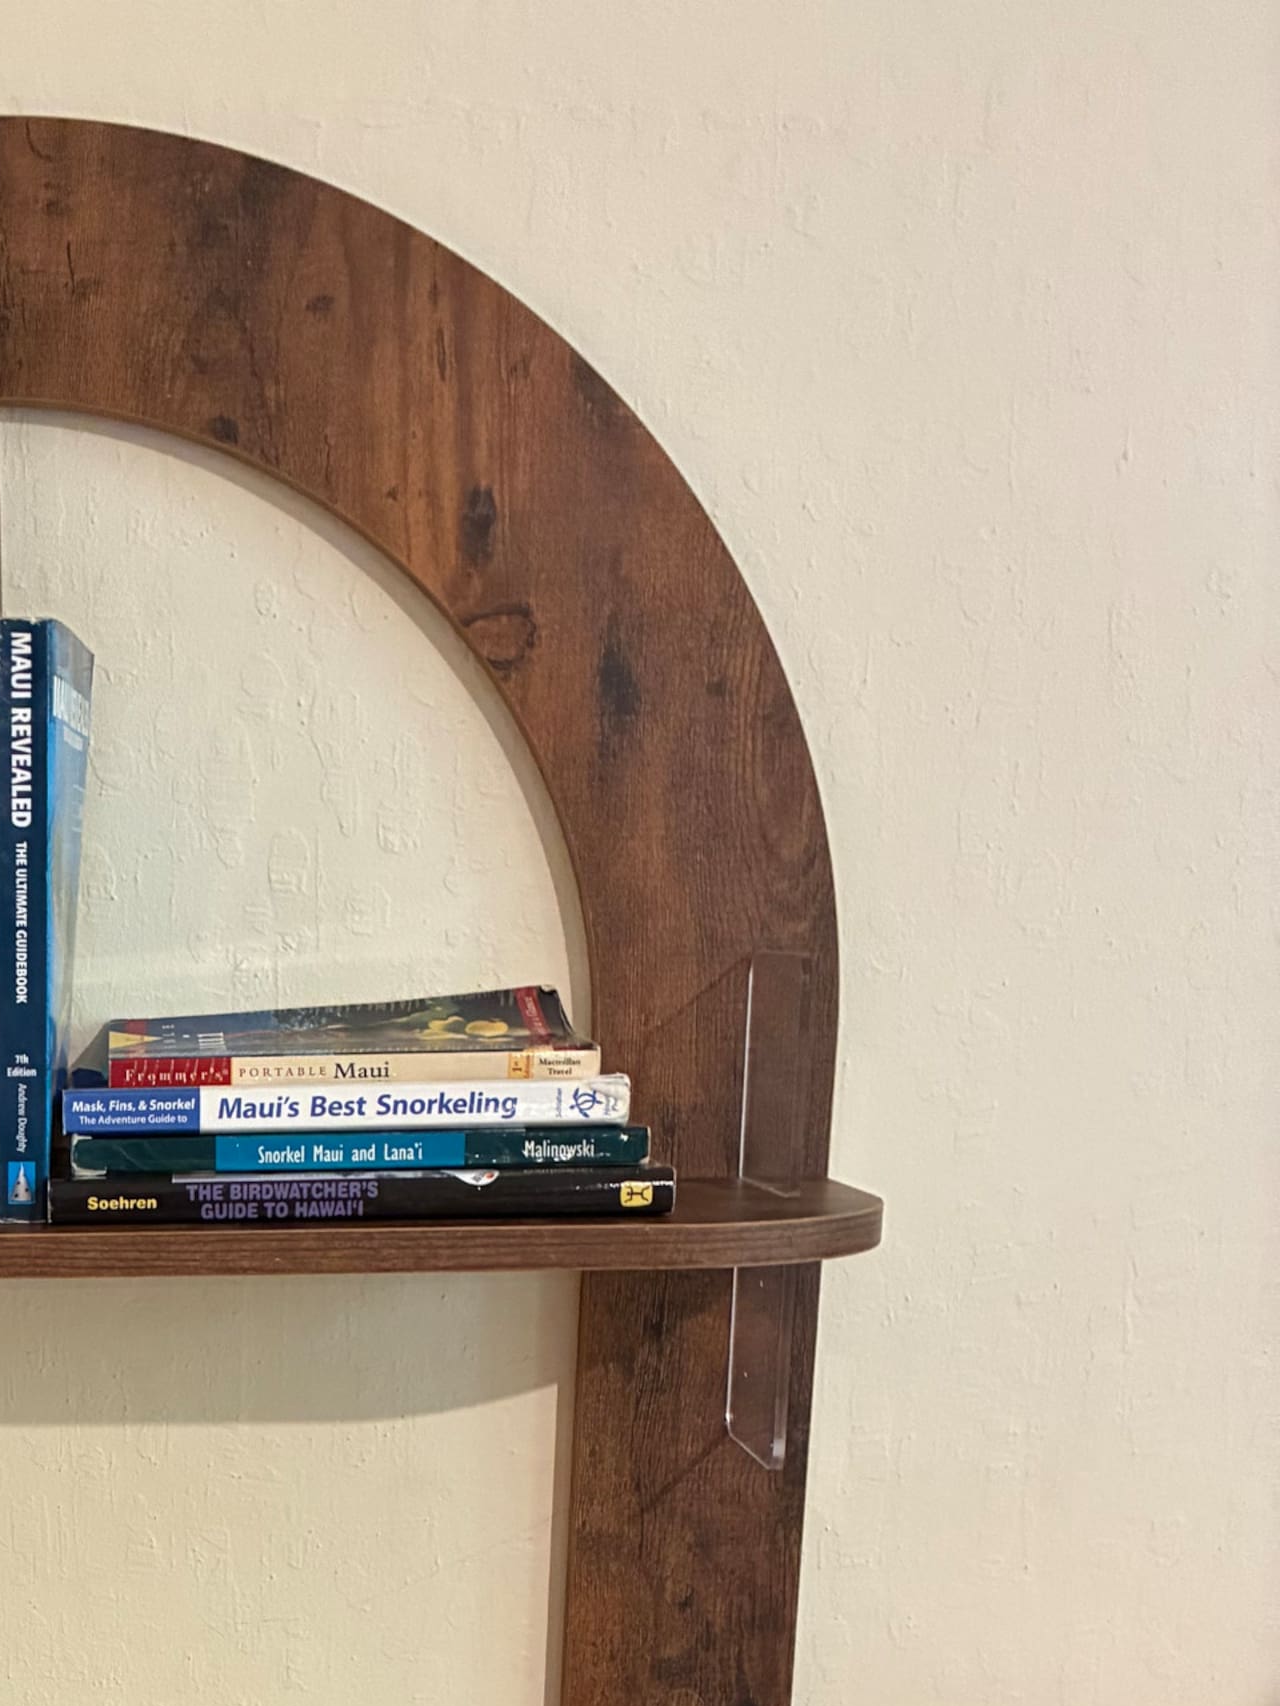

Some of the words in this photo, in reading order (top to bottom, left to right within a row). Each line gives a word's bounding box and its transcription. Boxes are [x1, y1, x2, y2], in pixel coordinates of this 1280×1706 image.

[10, 632, 32, 699] MAUI
[11, 707, 32, 828] REVEALED
[16, 841, 27, 866] THE
[15, 868, 27, 927] ULTIMATE
[15, 929, 27, 1004] GUIDEBOOK
[7, 1066, 37, 1077] Edition
[239, 1066, 327, 1078] PORTABLE
[334, 1061, 390, 1079] Maui
[539, 1057, 581, 1066] Macmillan
[547, 1067, 572, 1075] Travel
[17, 1083, 28, 1116] Andrew
[72, 1100, 106, 1113] Mask,
[109, 1099, 136, 1112] Fins,
[138, 1100, 147, 1111] &
[148, 1098, 195, 1111] Snorkel
[218, 1096, 299, 1119] Maui's
[310, 1096, 366, 1117] Best
[376, 1091, 518, 1118] Snorkeling
[79, 1115, 96, 1125] The
[98, 1114, 146, 1125] Adventure
[148, 1112, 176, 1124] Guide
[178, 1113, 188, 1123] to
[15, 1117, 28, 1153] Doughty
[258, 1146, 305, 1164] Snorkel
[313, 1145, 343, 1162] Maui
[351, 1144, 375, 1161] and
[524, 1139, 595, 1159] Malinowski
[186, 1184, 224, 1201] THE
[230, 1181, 378, 1200] BIRDWATCHER'S
[87, 1195, 157, 1211] Soehren
[201, 1202, 257, 1219] GUIDE
[263, 1202, 288, 1218] TO
